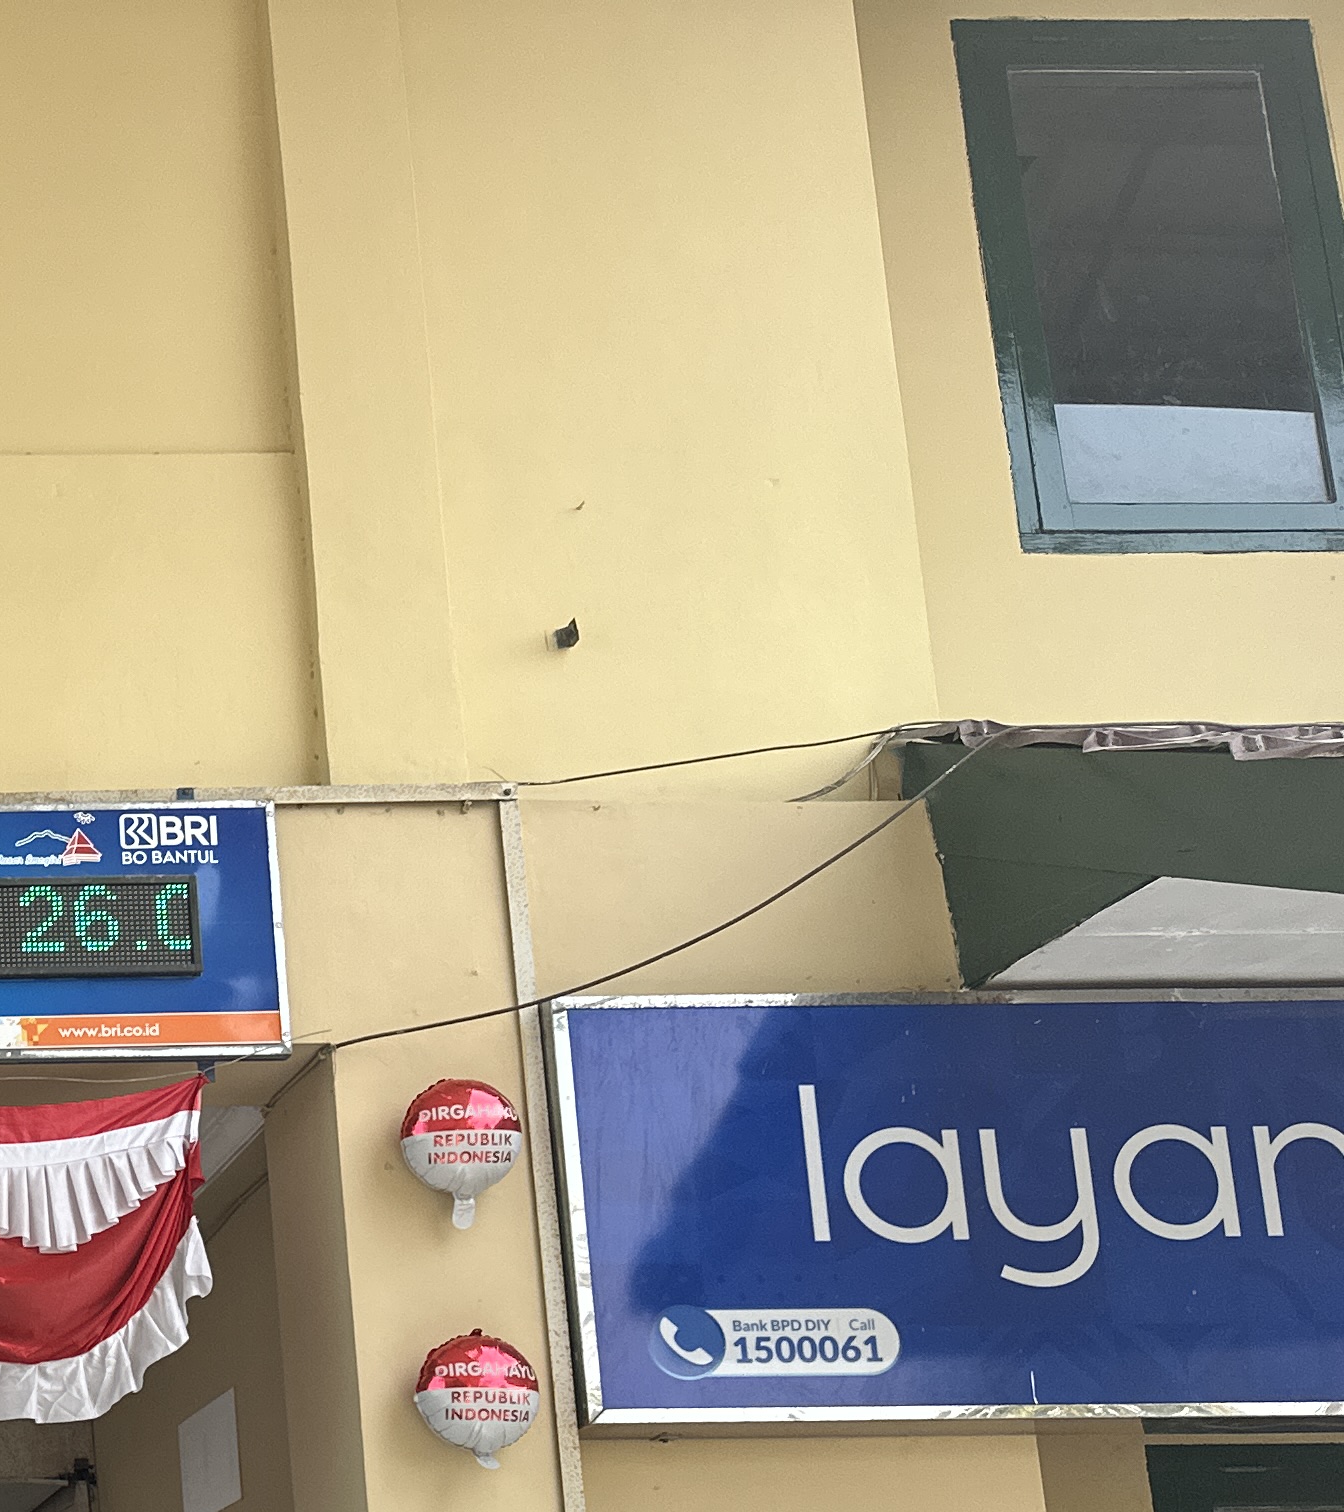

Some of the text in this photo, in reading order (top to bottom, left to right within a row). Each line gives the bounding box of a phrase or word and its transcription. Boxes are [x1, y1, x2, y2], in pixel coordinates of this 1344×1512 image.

[162, 815, 219, 847] BRI
[121, 850, 219, 865] BO BANTUL
[58, 1023, 160, 1038] www.bri.co.id
[433, 1132, 513, 1147] REPUBLIK
[427, 1150, 512, 1165] INDONESIA
[732, 1318, 876, 1332] Bank BPD DIY Call
[733, 1335, 883, 1364] 1500061
[434, 1361, 536, 1381] DIRGAHAYU
[451, 1390, 531, 1406] REPUBLIK
[445, 1408, 530, 1422] INDONESIA
